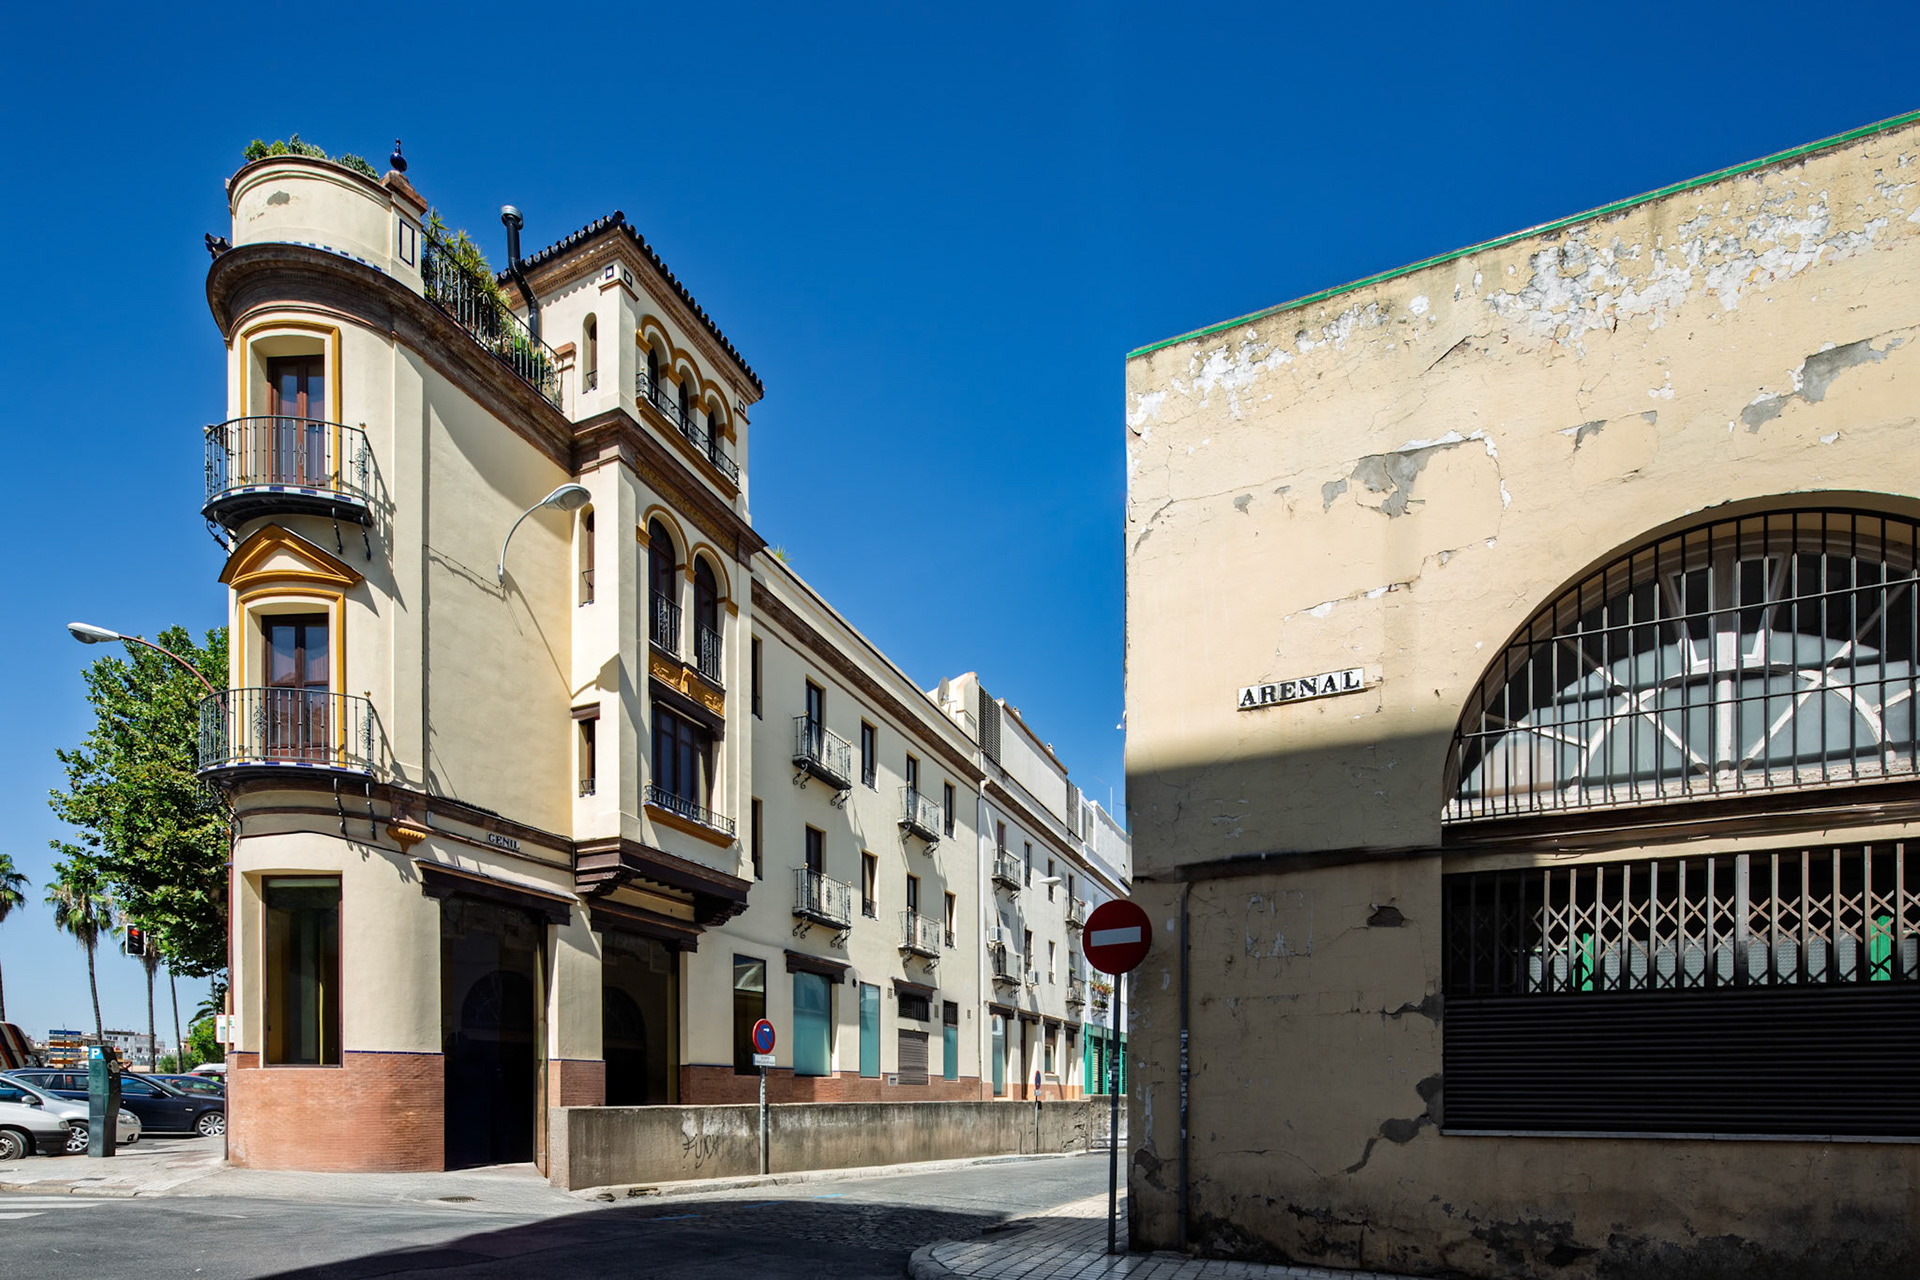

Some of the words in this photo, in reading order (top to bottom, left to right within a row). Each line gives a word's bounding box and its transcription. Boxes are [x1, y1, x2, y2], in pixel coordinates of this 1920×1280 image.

[1239, 671, 1361, 707] ARENAL
[488, 833, 520, 850] GENIL
[91, 1048, 100, 1059] P
